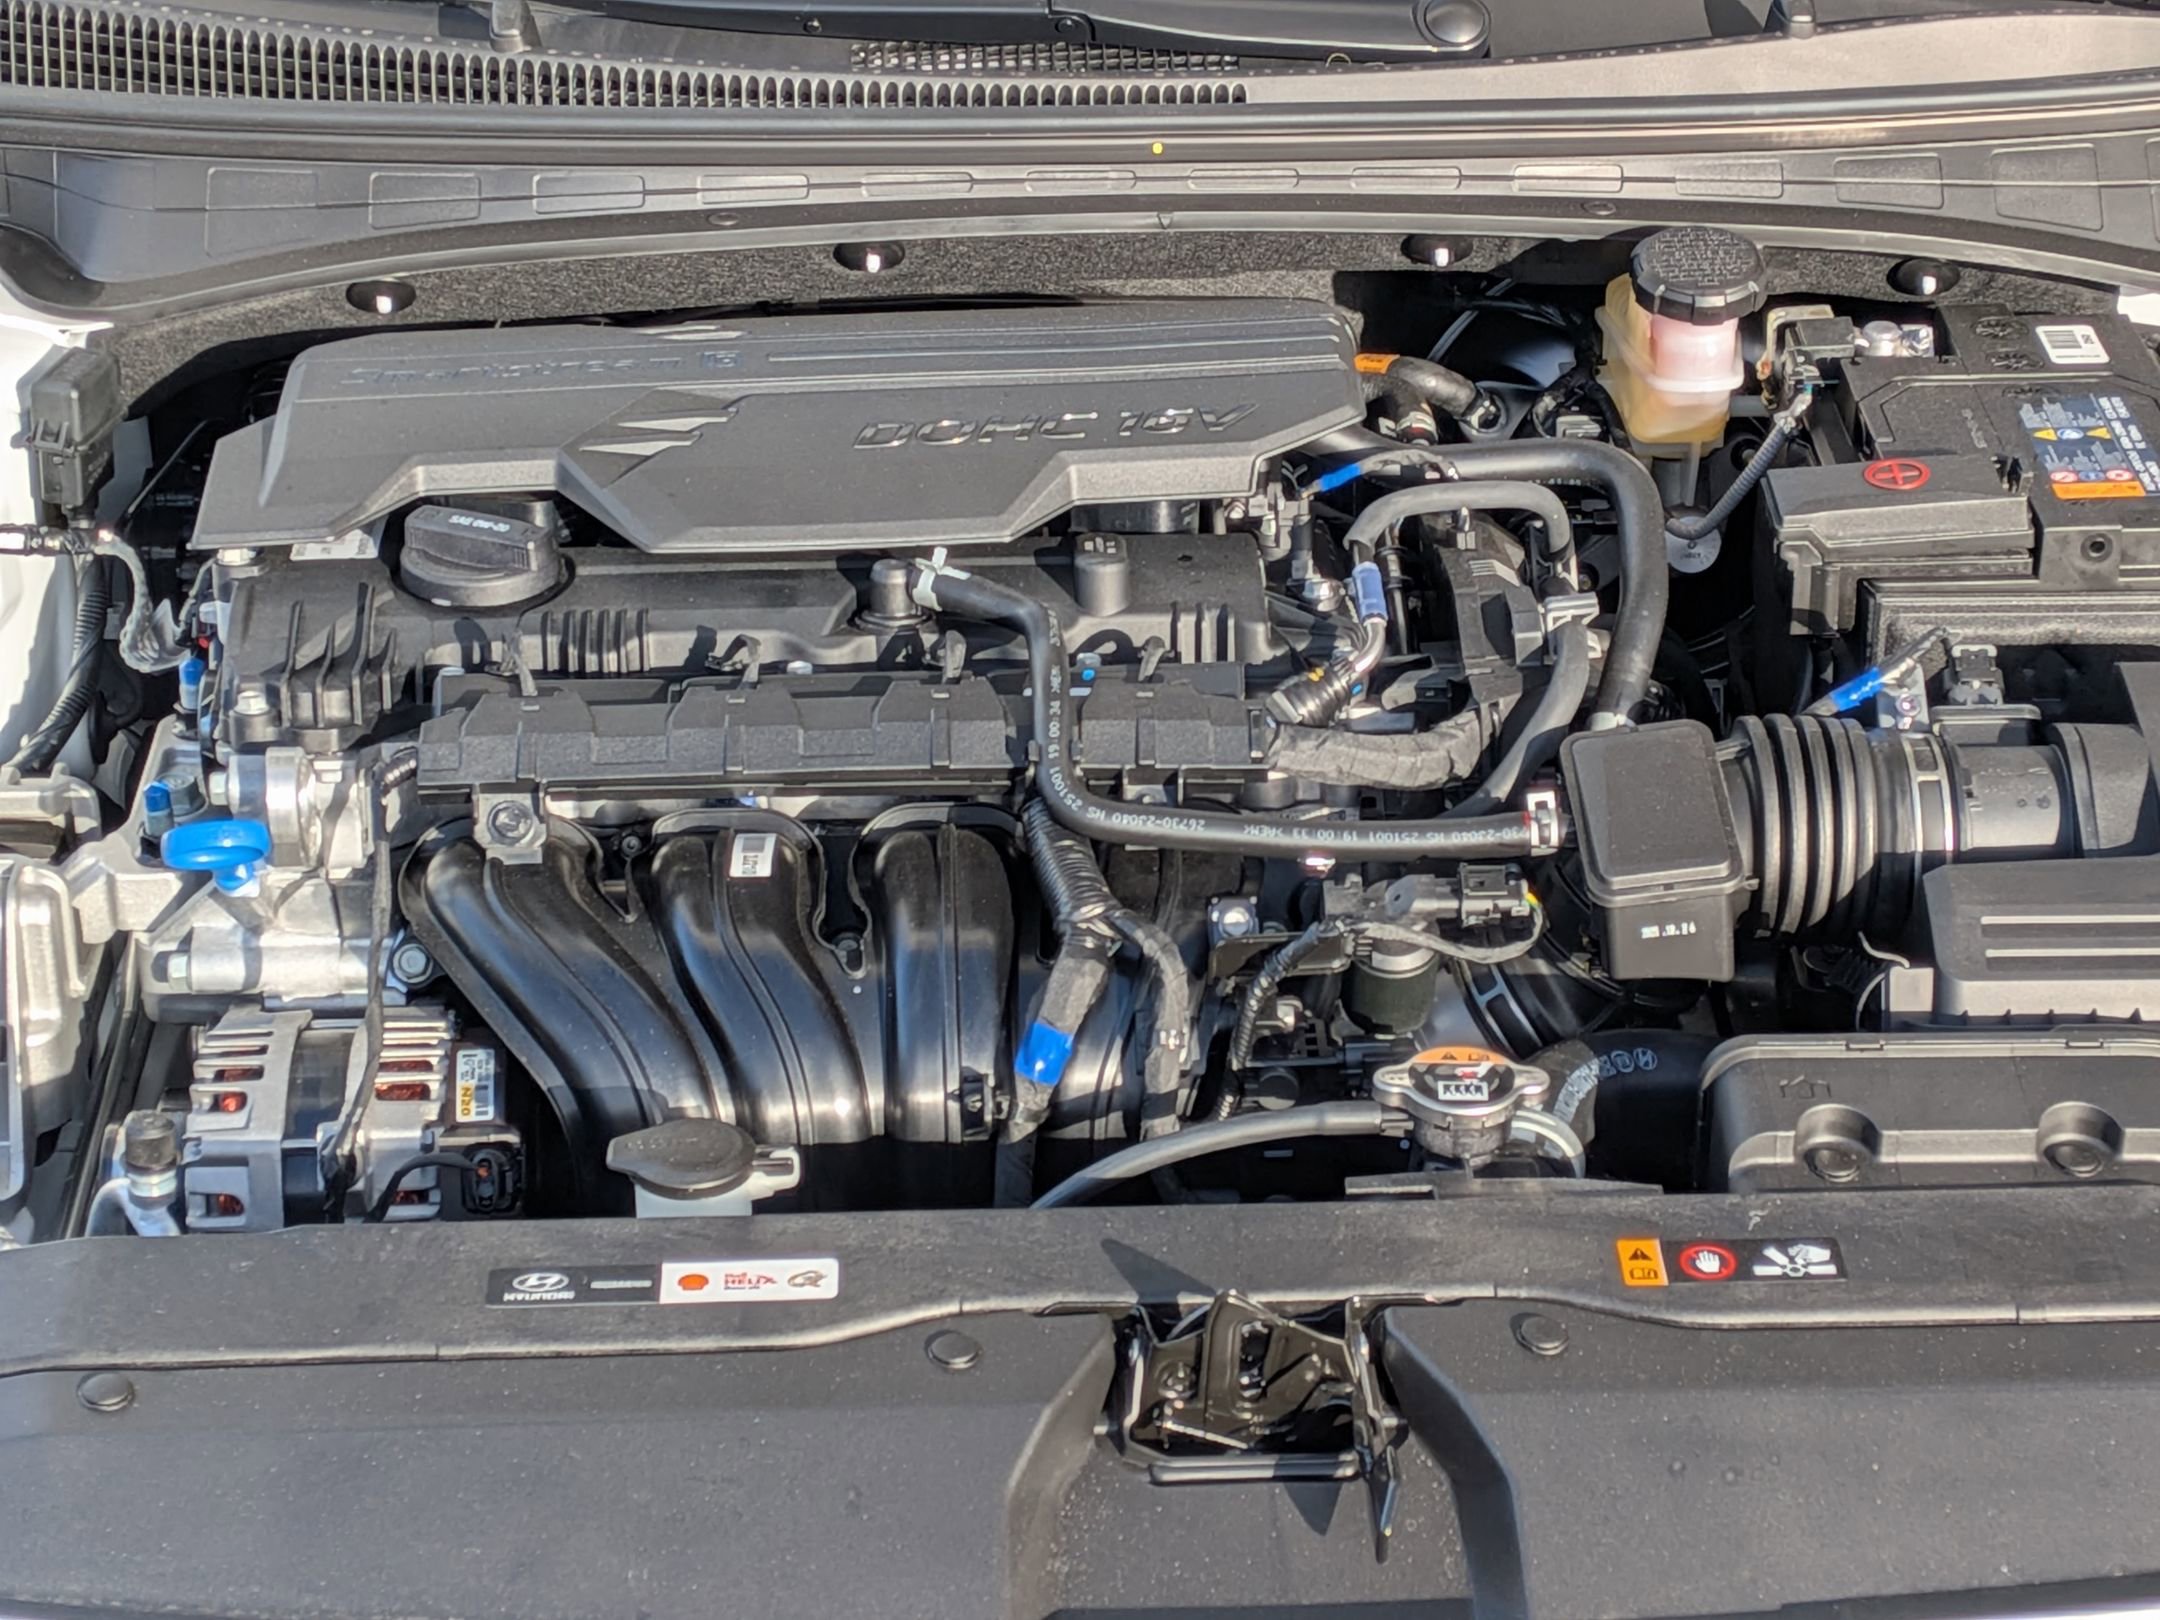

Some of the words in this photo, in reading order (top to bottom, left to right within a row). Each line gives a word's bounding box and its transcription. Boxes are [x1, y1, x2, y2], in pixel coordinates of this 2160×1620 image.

[853, 411, 1098, 450] DOHC
[1118, 403, 1258, 437] 16V
[448, 514, 474, 526] SAE
